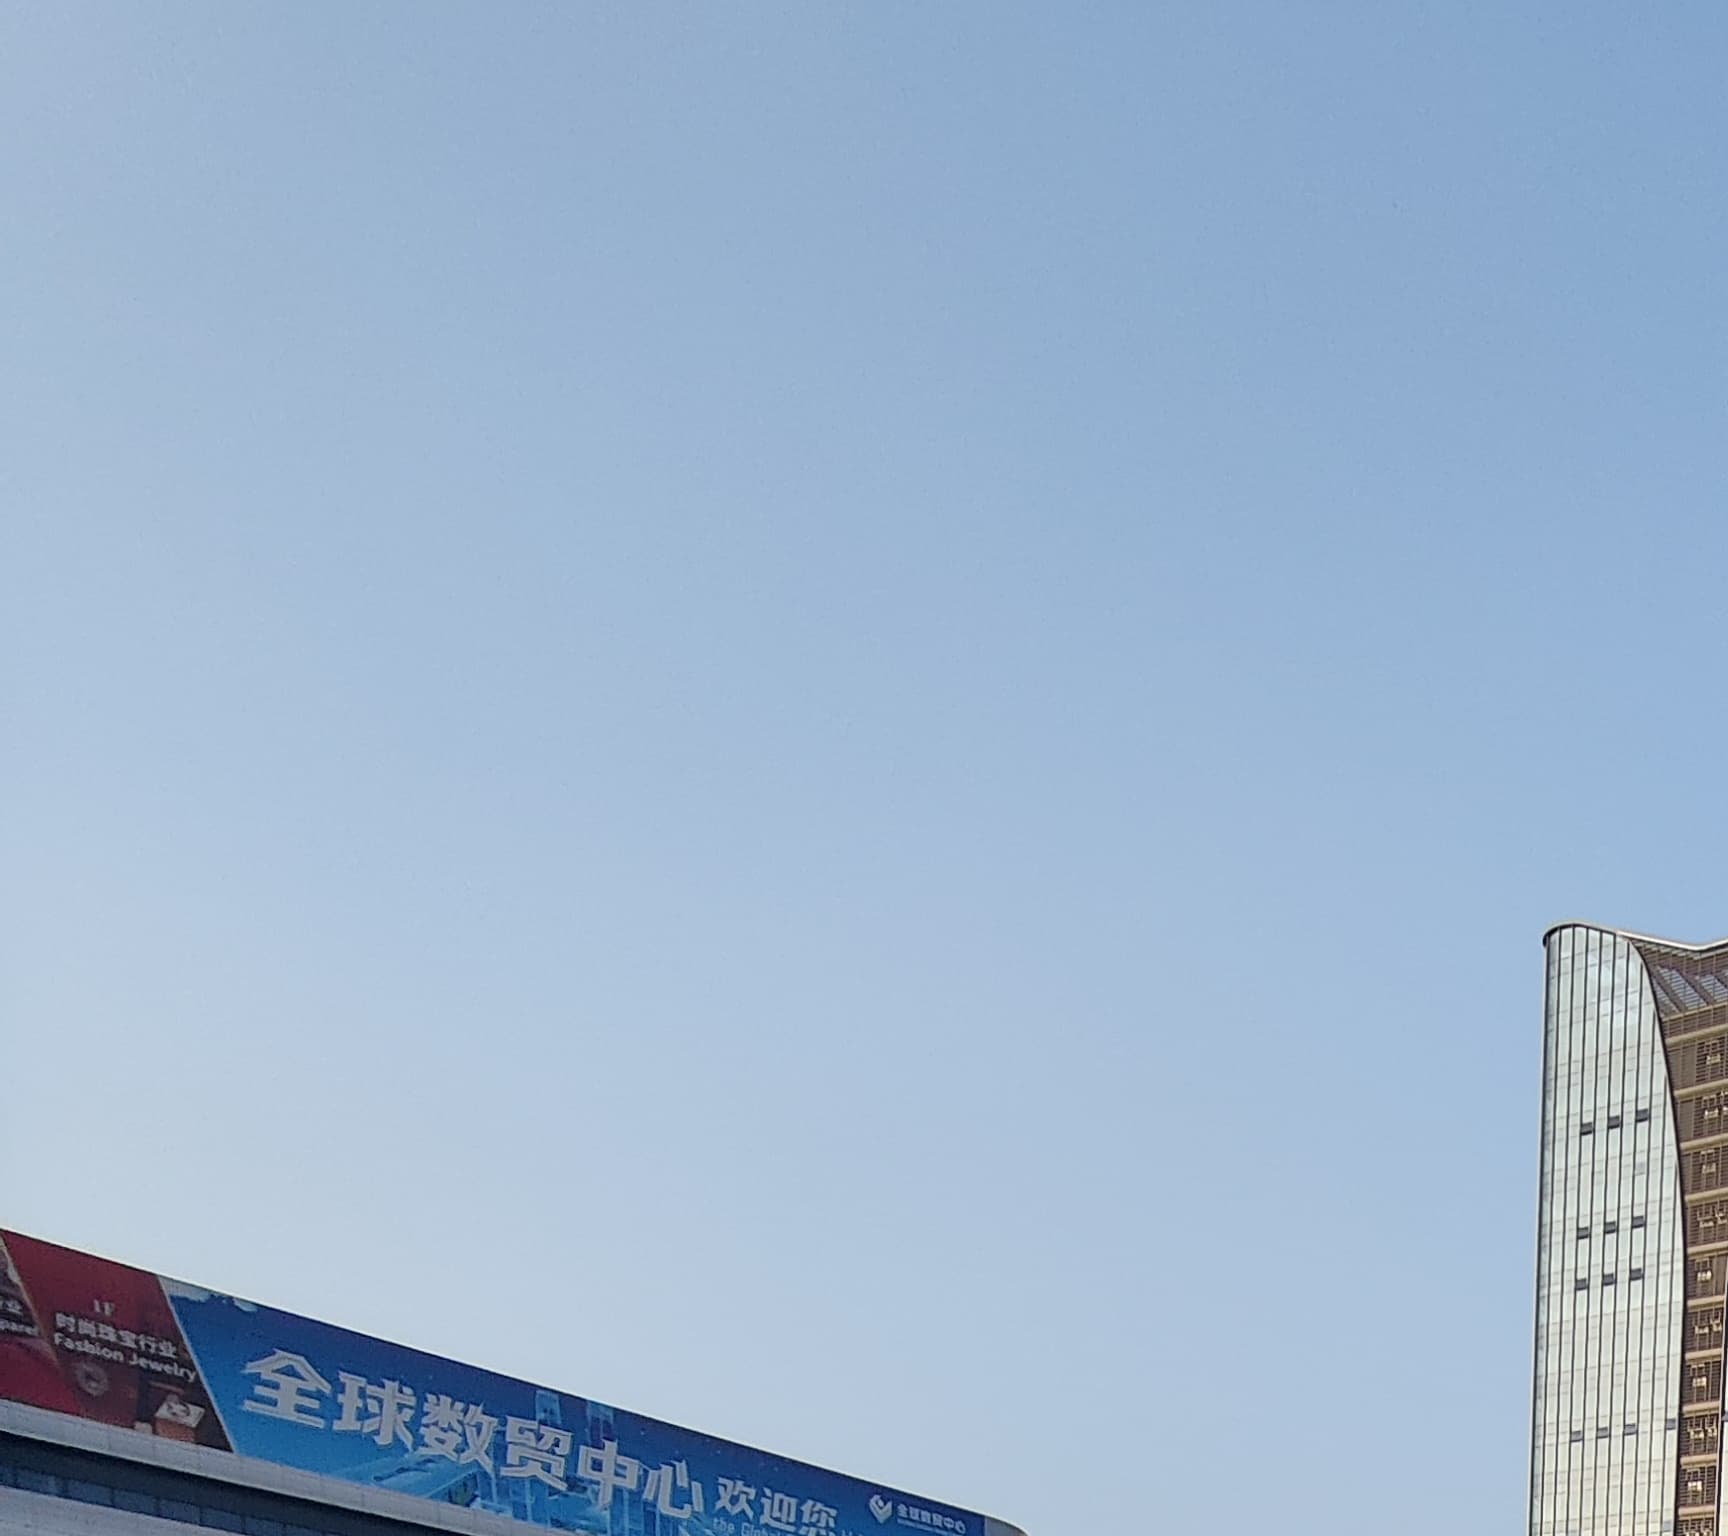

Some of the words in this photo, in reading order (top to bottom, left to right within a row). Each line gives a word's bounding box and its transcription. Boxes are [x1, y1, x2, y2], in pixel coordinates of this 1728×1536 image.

[54, 1332, 124, 1362] Fashion
[129, 1352, 197, 1383] Jewelry
[242, 1347, 703, 1520] 全球数贸中心
[712, 1517, 735, 1534] the
